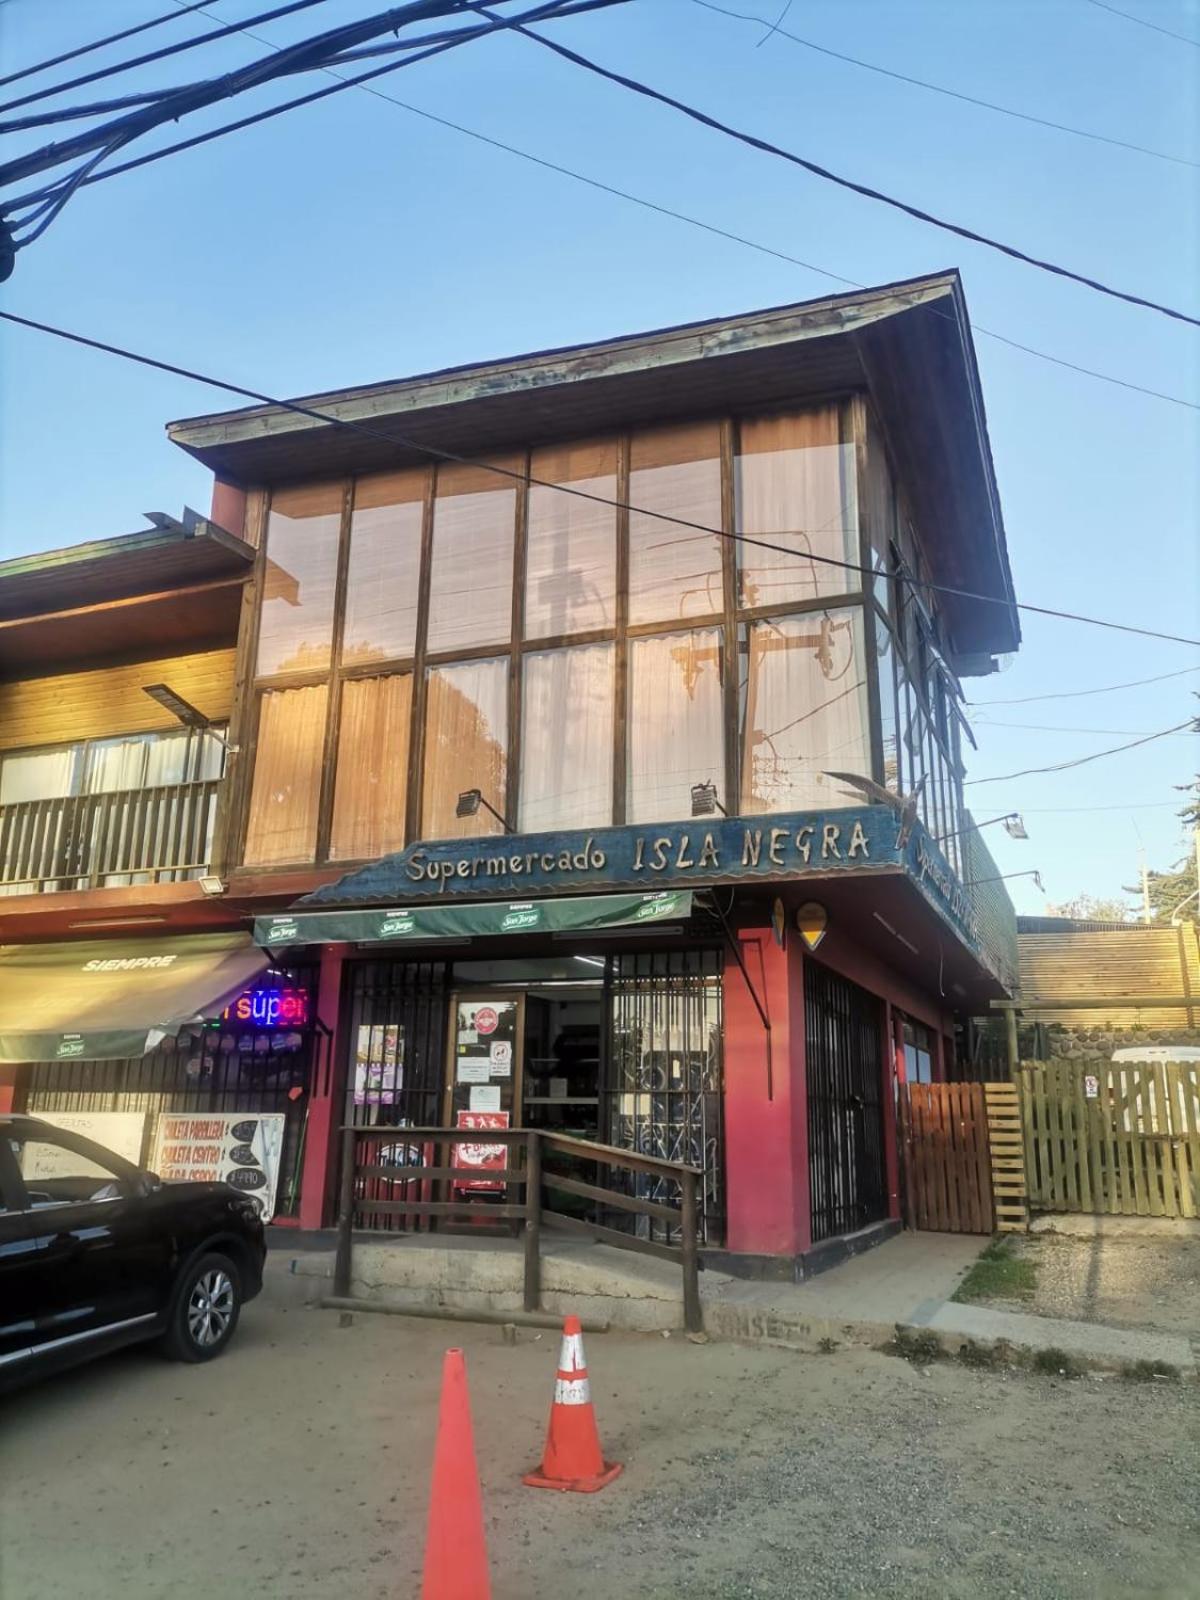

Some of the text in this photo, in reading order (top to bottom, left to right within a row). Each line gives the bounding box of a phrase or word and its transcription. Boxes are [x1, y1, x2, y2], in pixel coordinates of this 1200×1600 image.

[405, 820, 870, 894] Supermercado ISLA NEGRA
[81, 955, 178, 972] SIEMPRE
